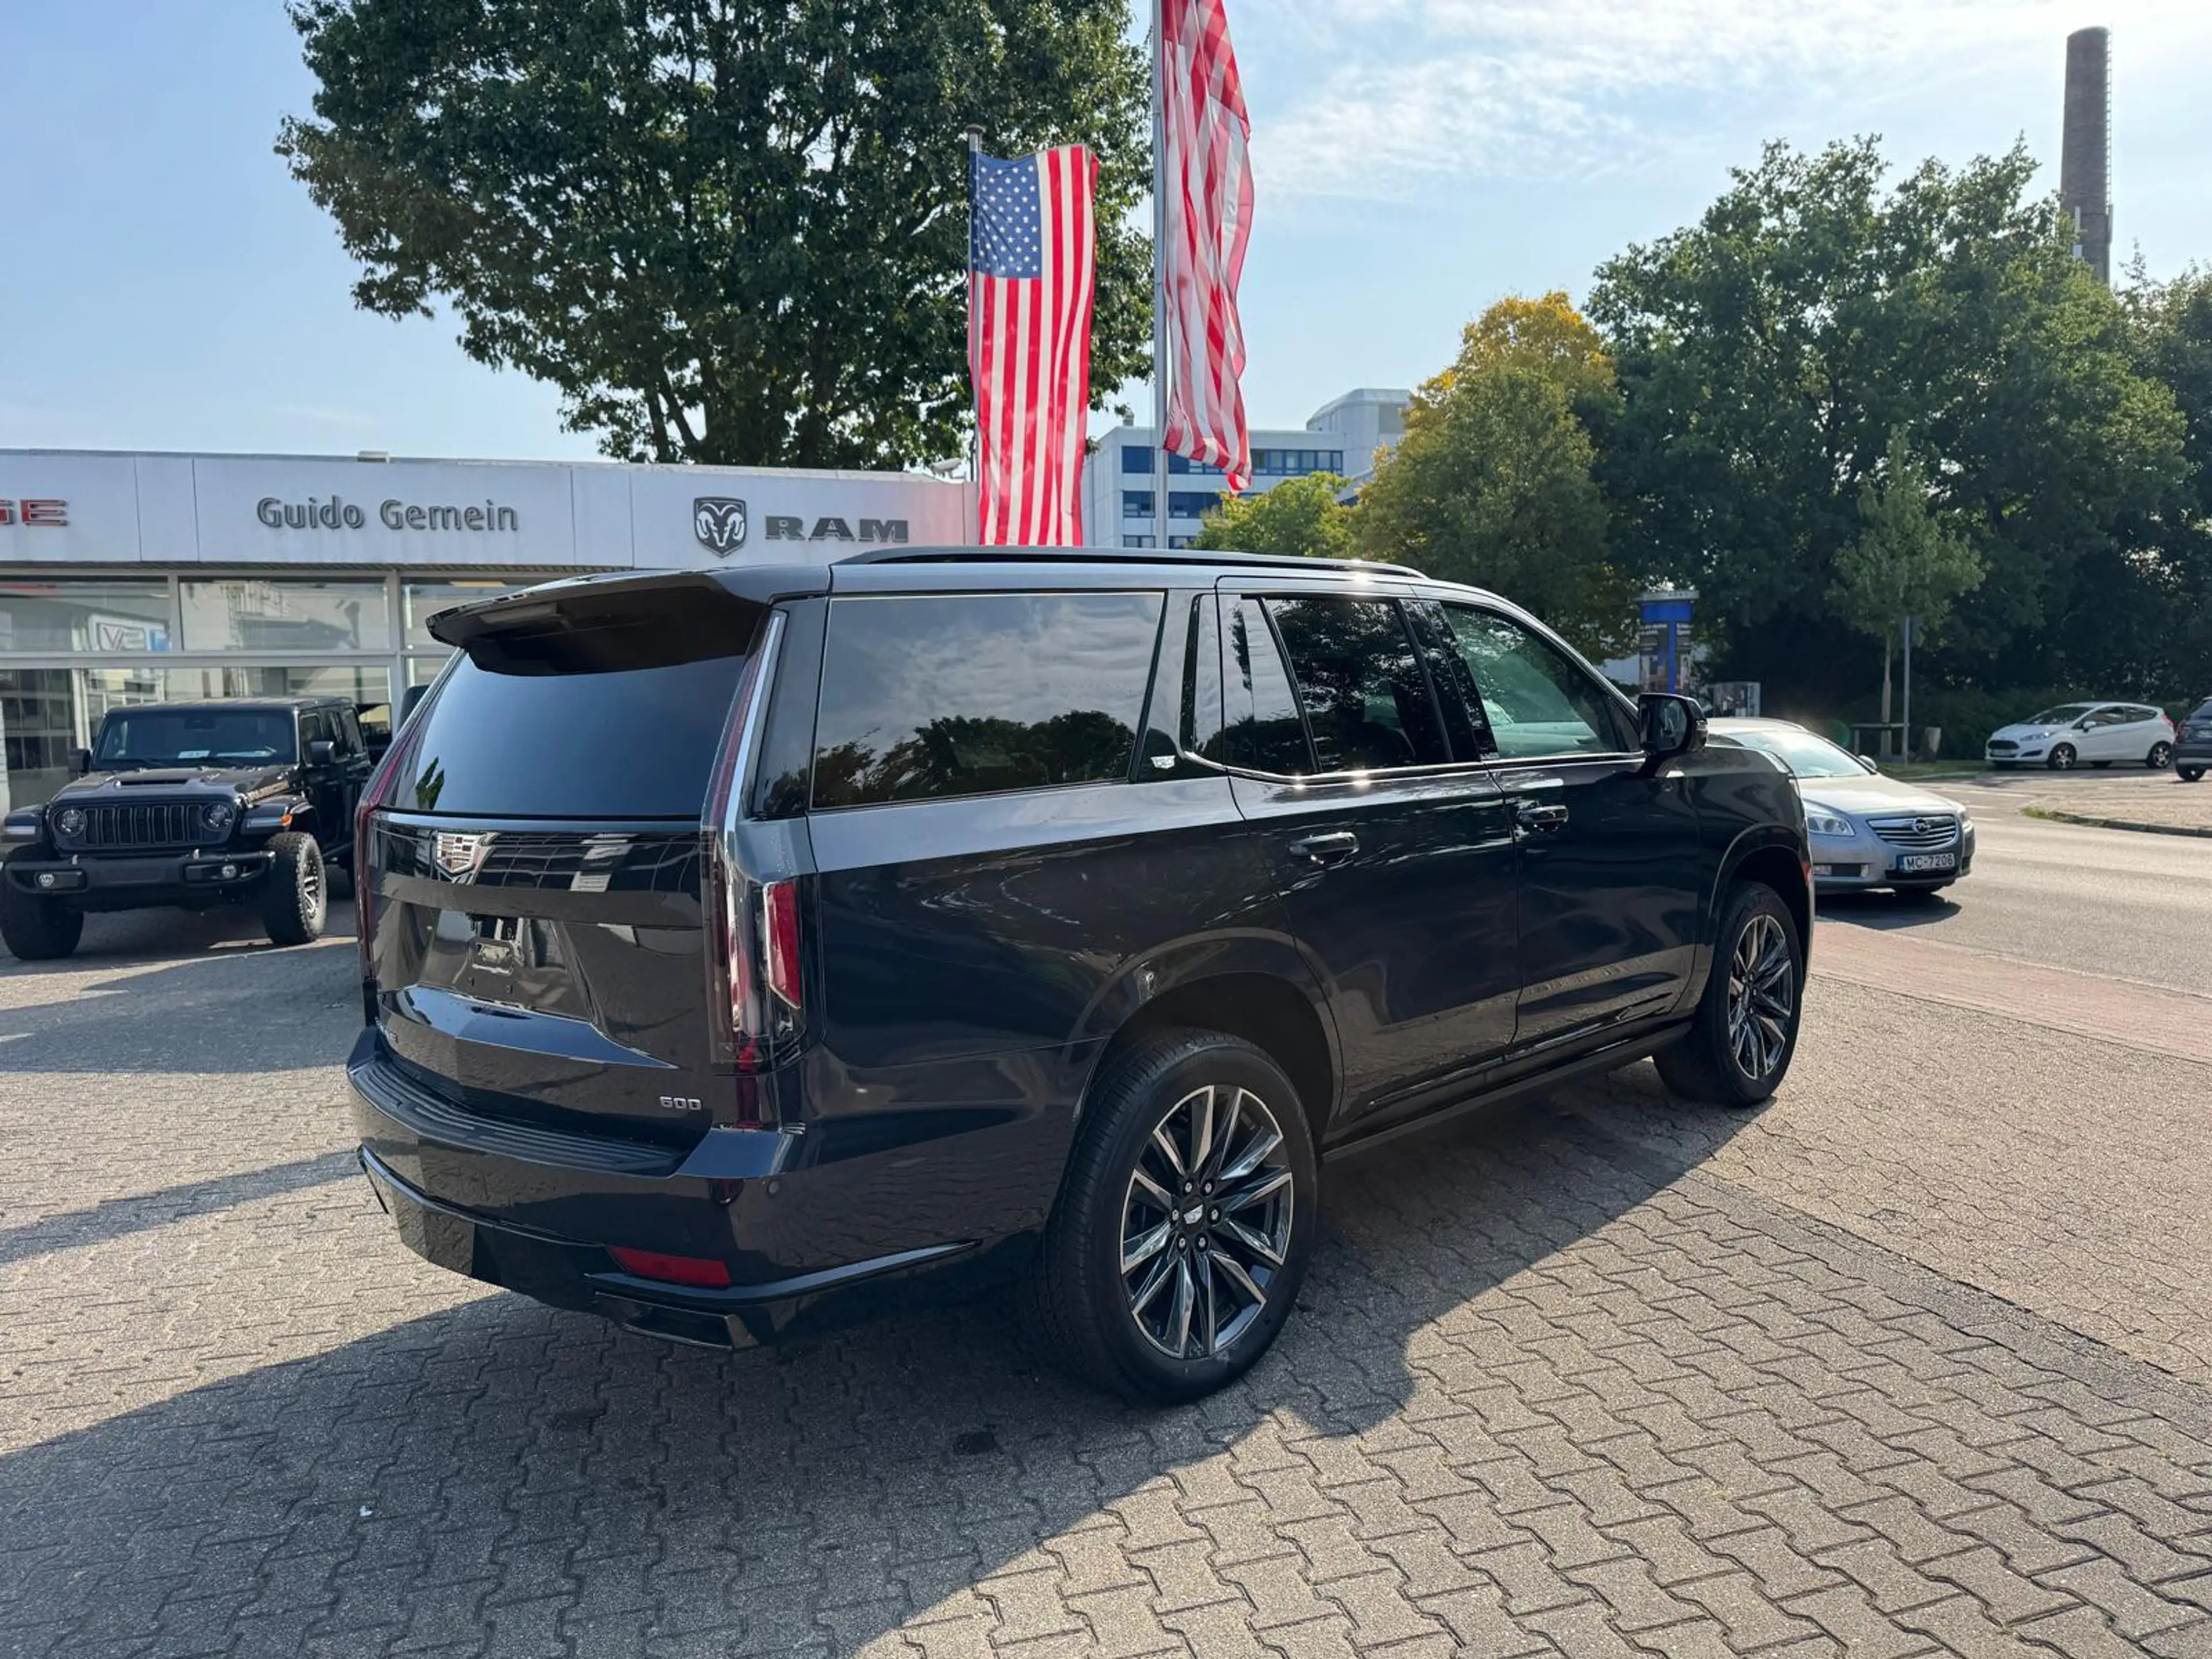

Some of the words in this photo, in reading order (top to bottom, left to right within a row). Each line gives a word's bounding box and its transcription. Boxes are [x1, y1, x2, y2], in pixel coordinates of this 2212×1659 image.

[257, 495, 364, 529] Guido
[380, 499, 518, 531] Gemein
[764, 515, 908, 543] RAM
[659, 1096, 702, 1110] 600
